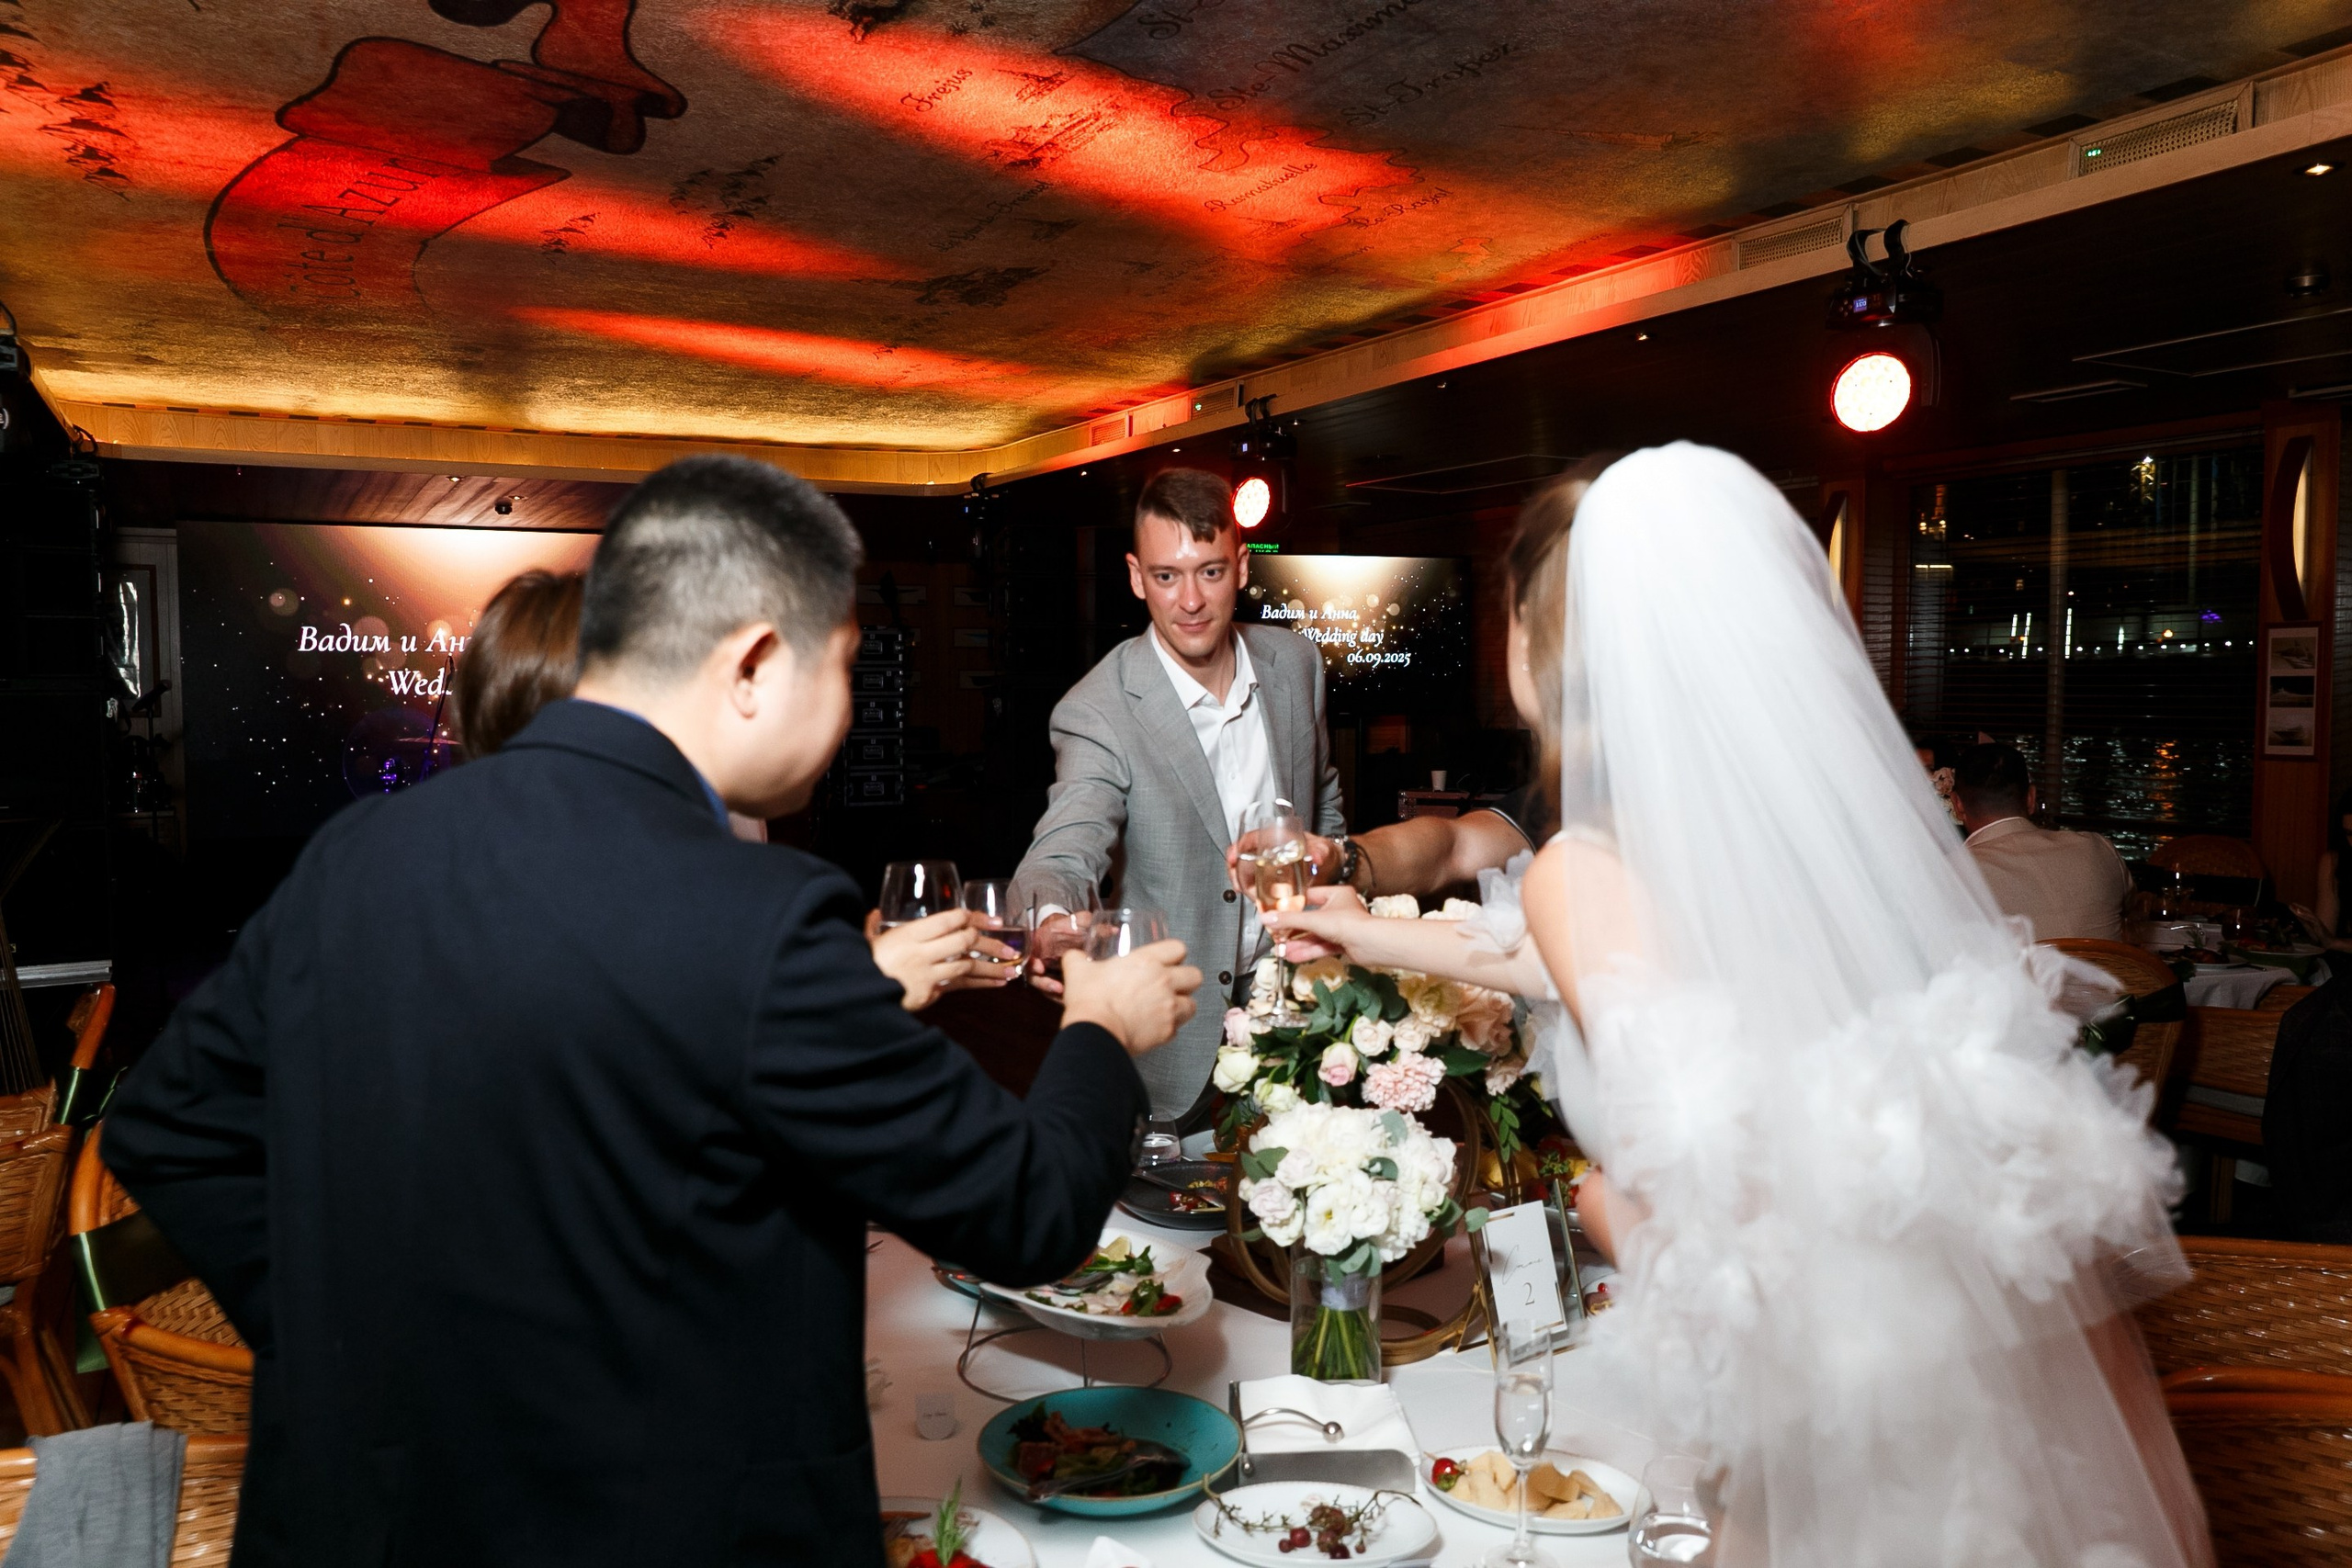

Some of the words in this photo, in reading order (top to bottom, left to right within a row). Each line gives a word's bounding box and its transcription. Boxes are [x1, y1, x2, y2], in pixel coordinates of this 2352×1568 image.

[1206, 0, 1423, 111] Ste-Maxim
[1204, 163, 1317, 212] Ramatuelle
[1261, 603, 1305, 619] Вадим
[1309, 609, 1318, 619] и
[1320, 603, 1357, 620] Анна
[298, 623, 391, 652] Вадим
[401, 635, 417, 652] и
[424, 627, 472, 652] Ан
[1302, 626, 1358, 647] Wedding
[1360, 626, 1385, 647] day
[1347, 649, 1411, 668] 06.09.2025
[1522, 1282, 1535, 1305] 2
